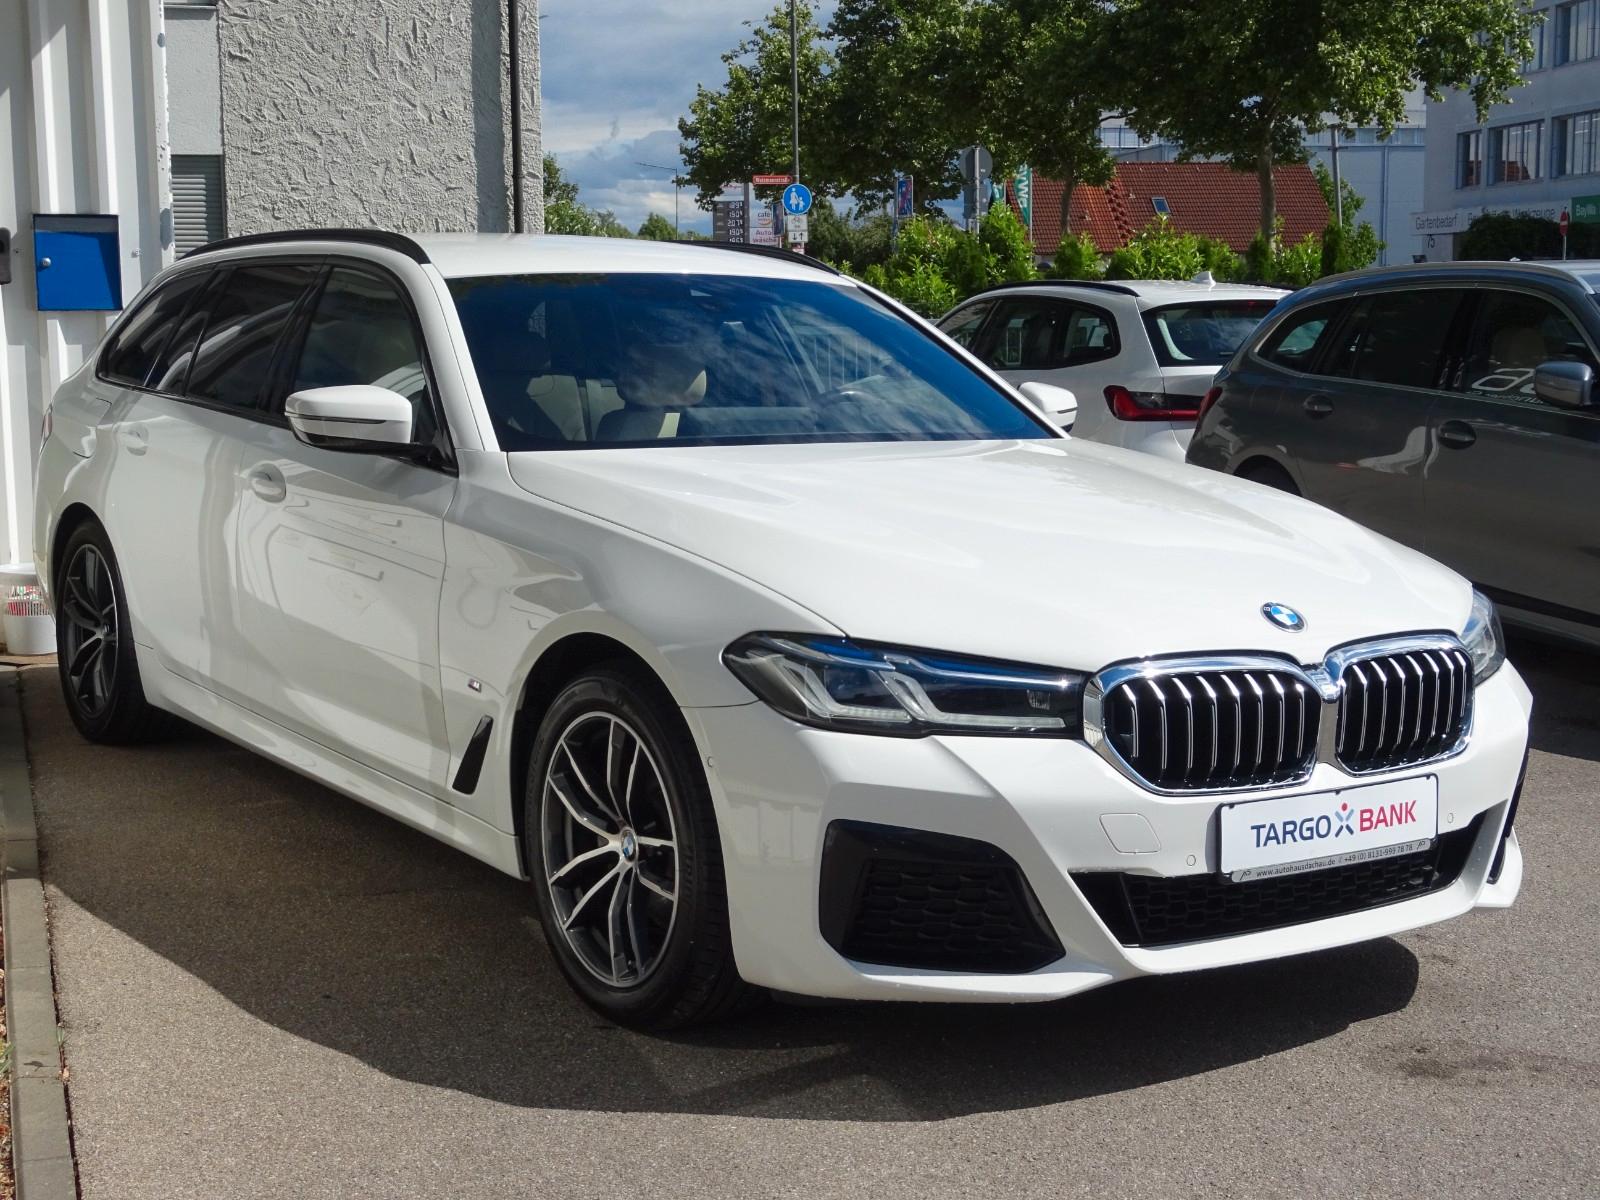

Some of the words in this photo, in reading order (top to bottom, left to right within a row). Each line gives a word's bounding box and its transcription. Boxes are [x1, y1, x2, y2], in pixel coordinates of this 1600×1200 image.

[1415, 214, 1457, 230] Gartenbedarf
[1250, 814, 1332, 848] TARGO
[1359, 800, 1417, 832] BANK
[1256, 857, 1336, 878] www.autohausdachau.de
